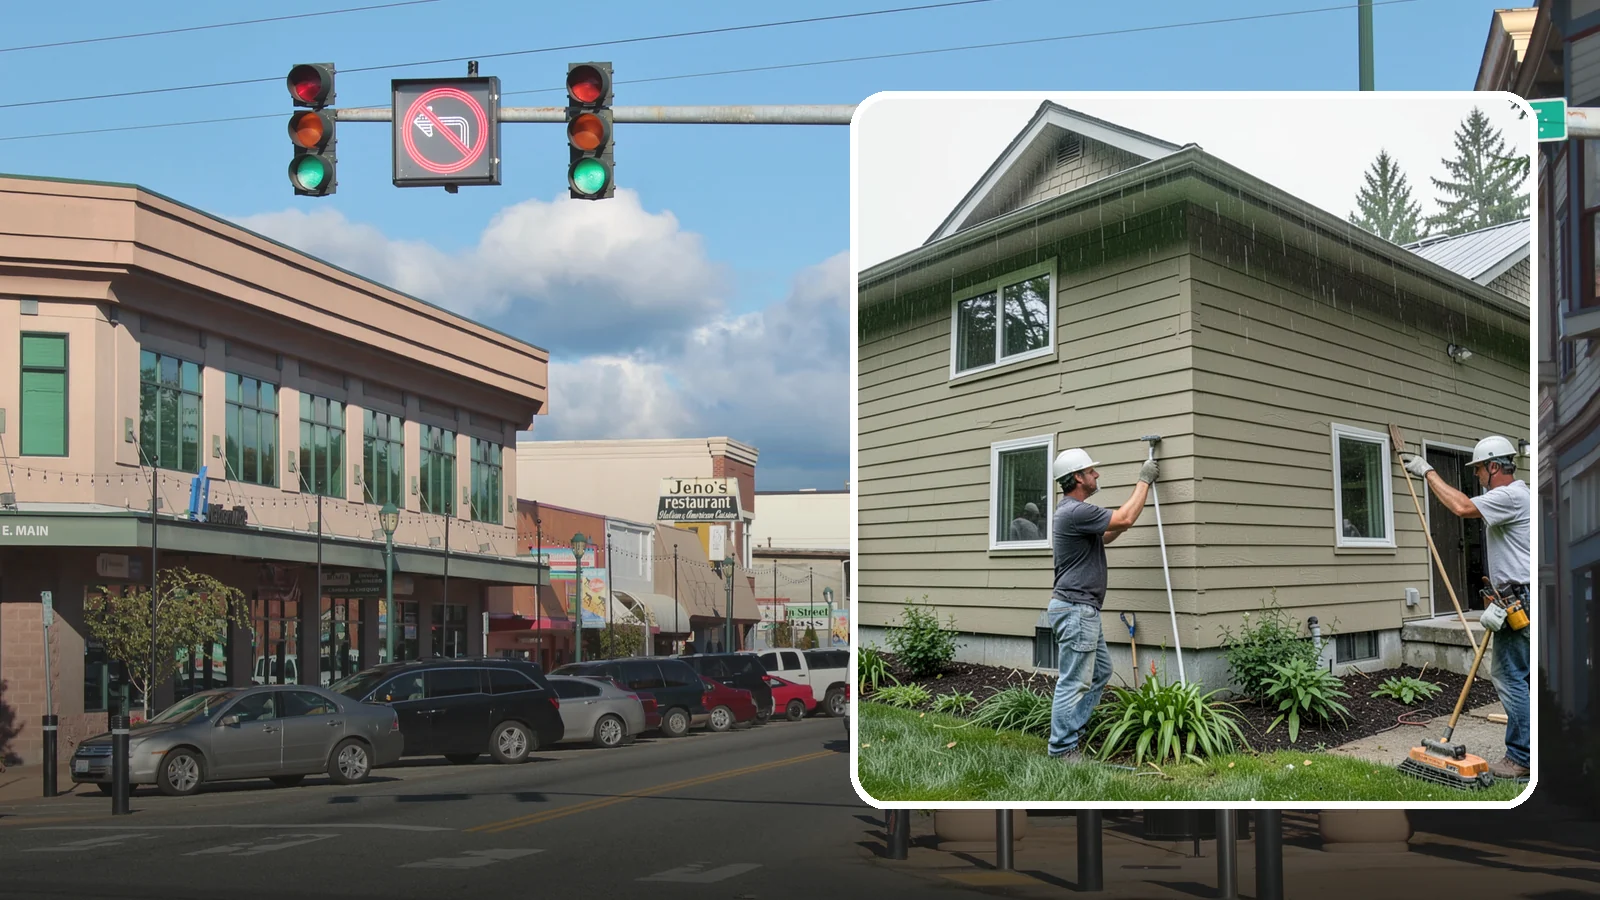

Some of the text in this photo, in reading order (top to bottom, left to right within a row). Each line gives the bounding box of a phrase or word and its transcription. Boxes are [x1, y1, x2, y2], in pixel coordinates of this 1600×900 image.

[669, 480, 728, 495] Jeno's
[665, 496, 731, 509] restaurant
[658, 510, 682, 520] Italian
[686, 509, 715, 520] American
[715, 509, 738, 520] Cuisine
[2, 525, 49, 536] E. MAIN
[797, 607, 828, 617] Street
[790, 619, 824, 627] lass
